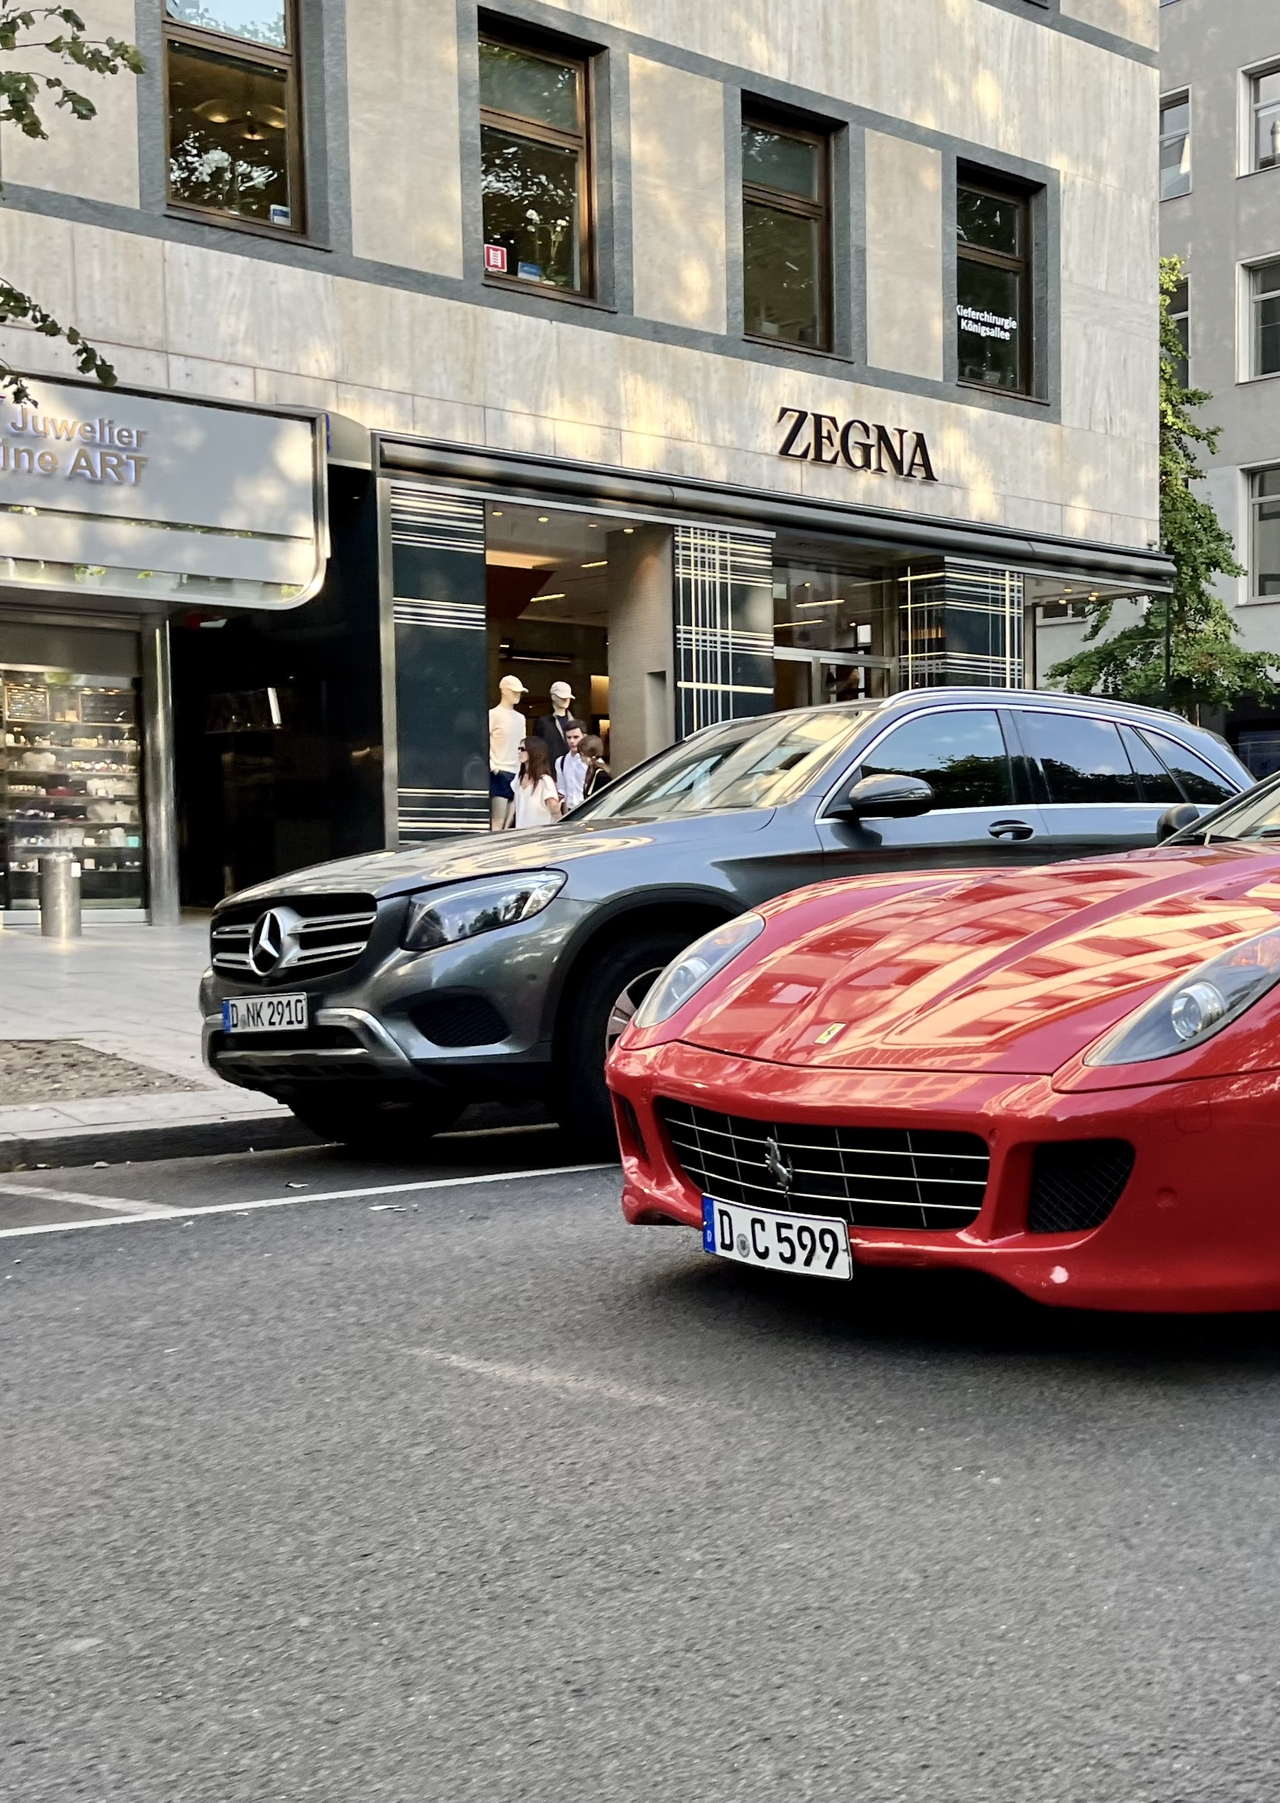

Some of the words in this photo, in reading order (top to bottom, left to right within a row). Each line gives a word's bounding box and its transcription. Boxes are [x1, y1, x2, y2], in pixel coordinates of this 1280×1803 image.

[960, 318, 1011, 341] Königsallee
[11, 405, 148, 449] Juwelier
[776, 406, 939, 482] ZEGNA
[0, 438, 59, 475] ine
[69, 448, 149, 486] ART
[231, 1003, 239, 1028] D
[246, 1002, 265, 1027] NK
[267, 999, 304, 1027] 2910
[718, 1208, 734, 1252] D
[750, 1217, 770, 1260] C
[775, 1221, 839, 1270] 599
